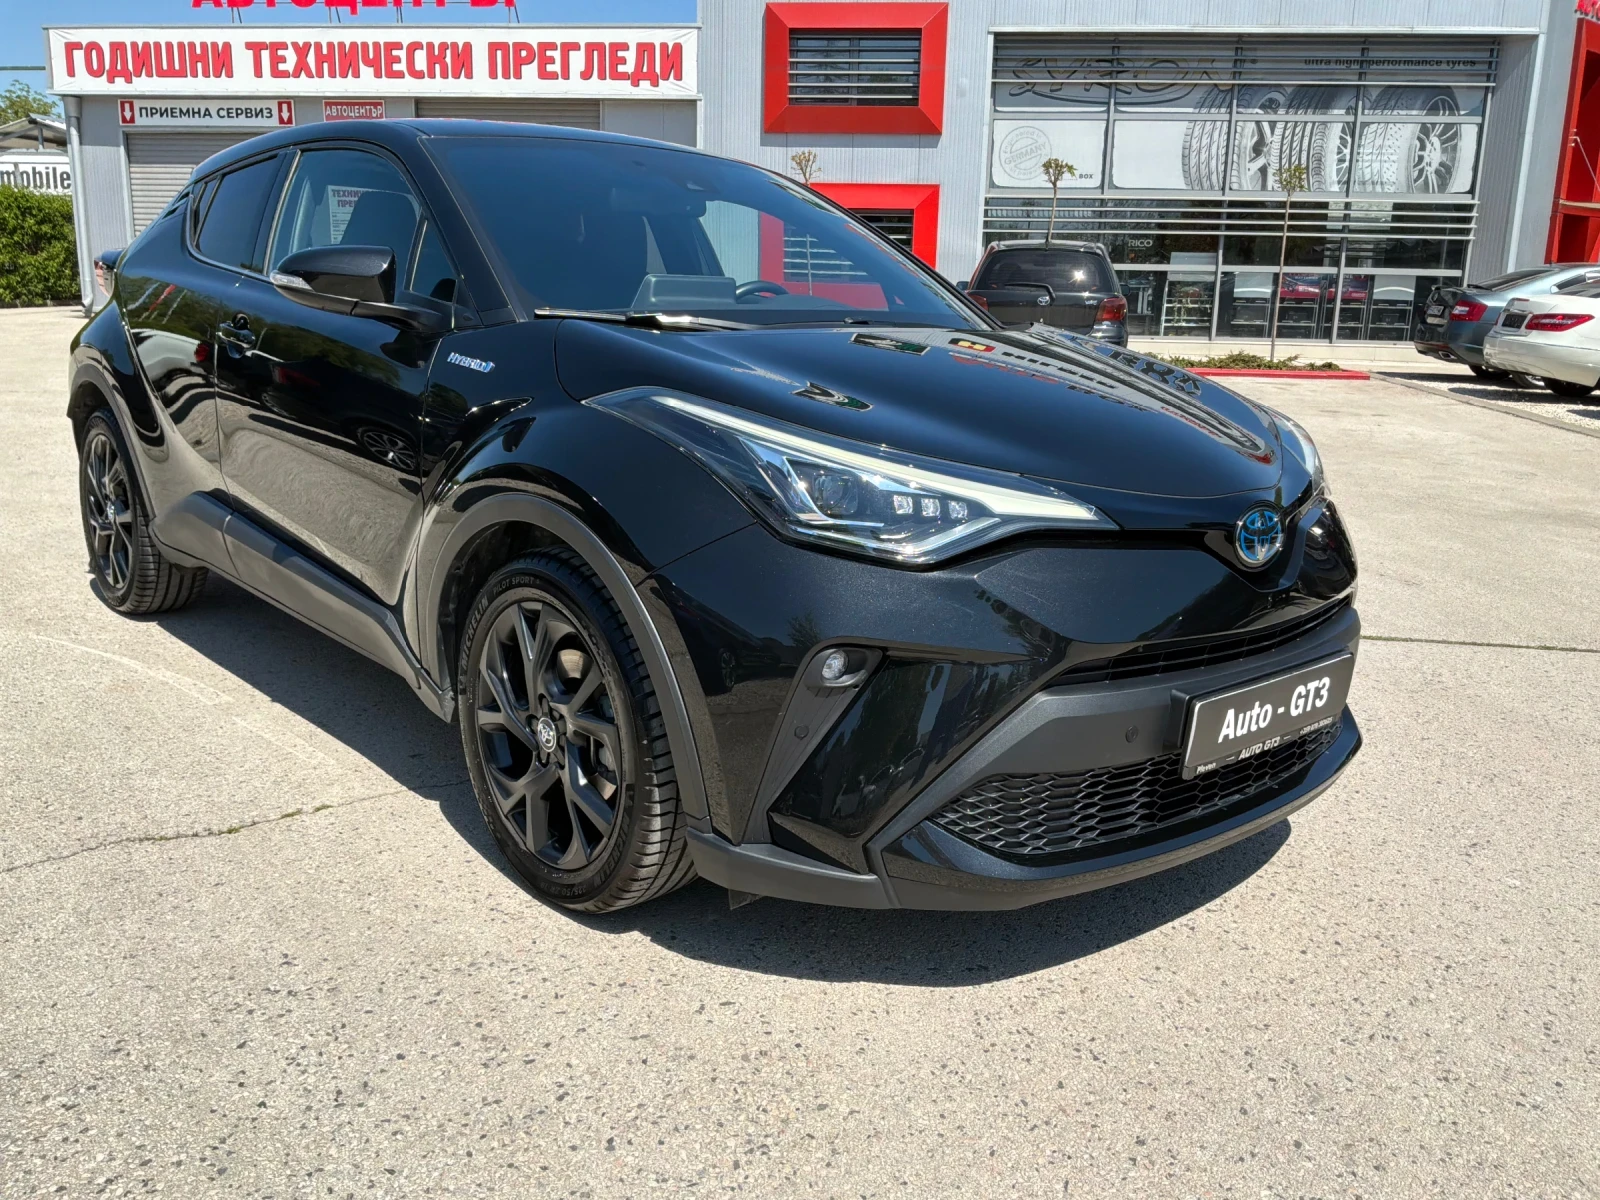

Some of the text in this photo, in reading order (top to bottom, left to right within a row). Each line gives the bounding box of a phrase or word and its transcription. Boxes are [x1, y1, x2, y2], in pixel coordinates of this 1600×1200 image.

[64, 41, 683, 87] ГОДИШНИ ТЕХНИЧЕСКИ ПРЕГЛЕДИ
[139, 105, 273, 119] ПРИЕМНА СЕРВИЗ
[325, 105, 383, 118] АВТОЦЕНТЪР
[1004, 142, 1047, 165] GERMANY
[492, 579, 510, 595] PILOT
[512, 576, 535, 585] SPORT
[461, 595, 489, 671] MICHELIN
[1217, 701, 1272, 744] Auto
[1290, 676, 1331, 717] GT3
[1238, 736, 1281, 760] AUTO GT3
